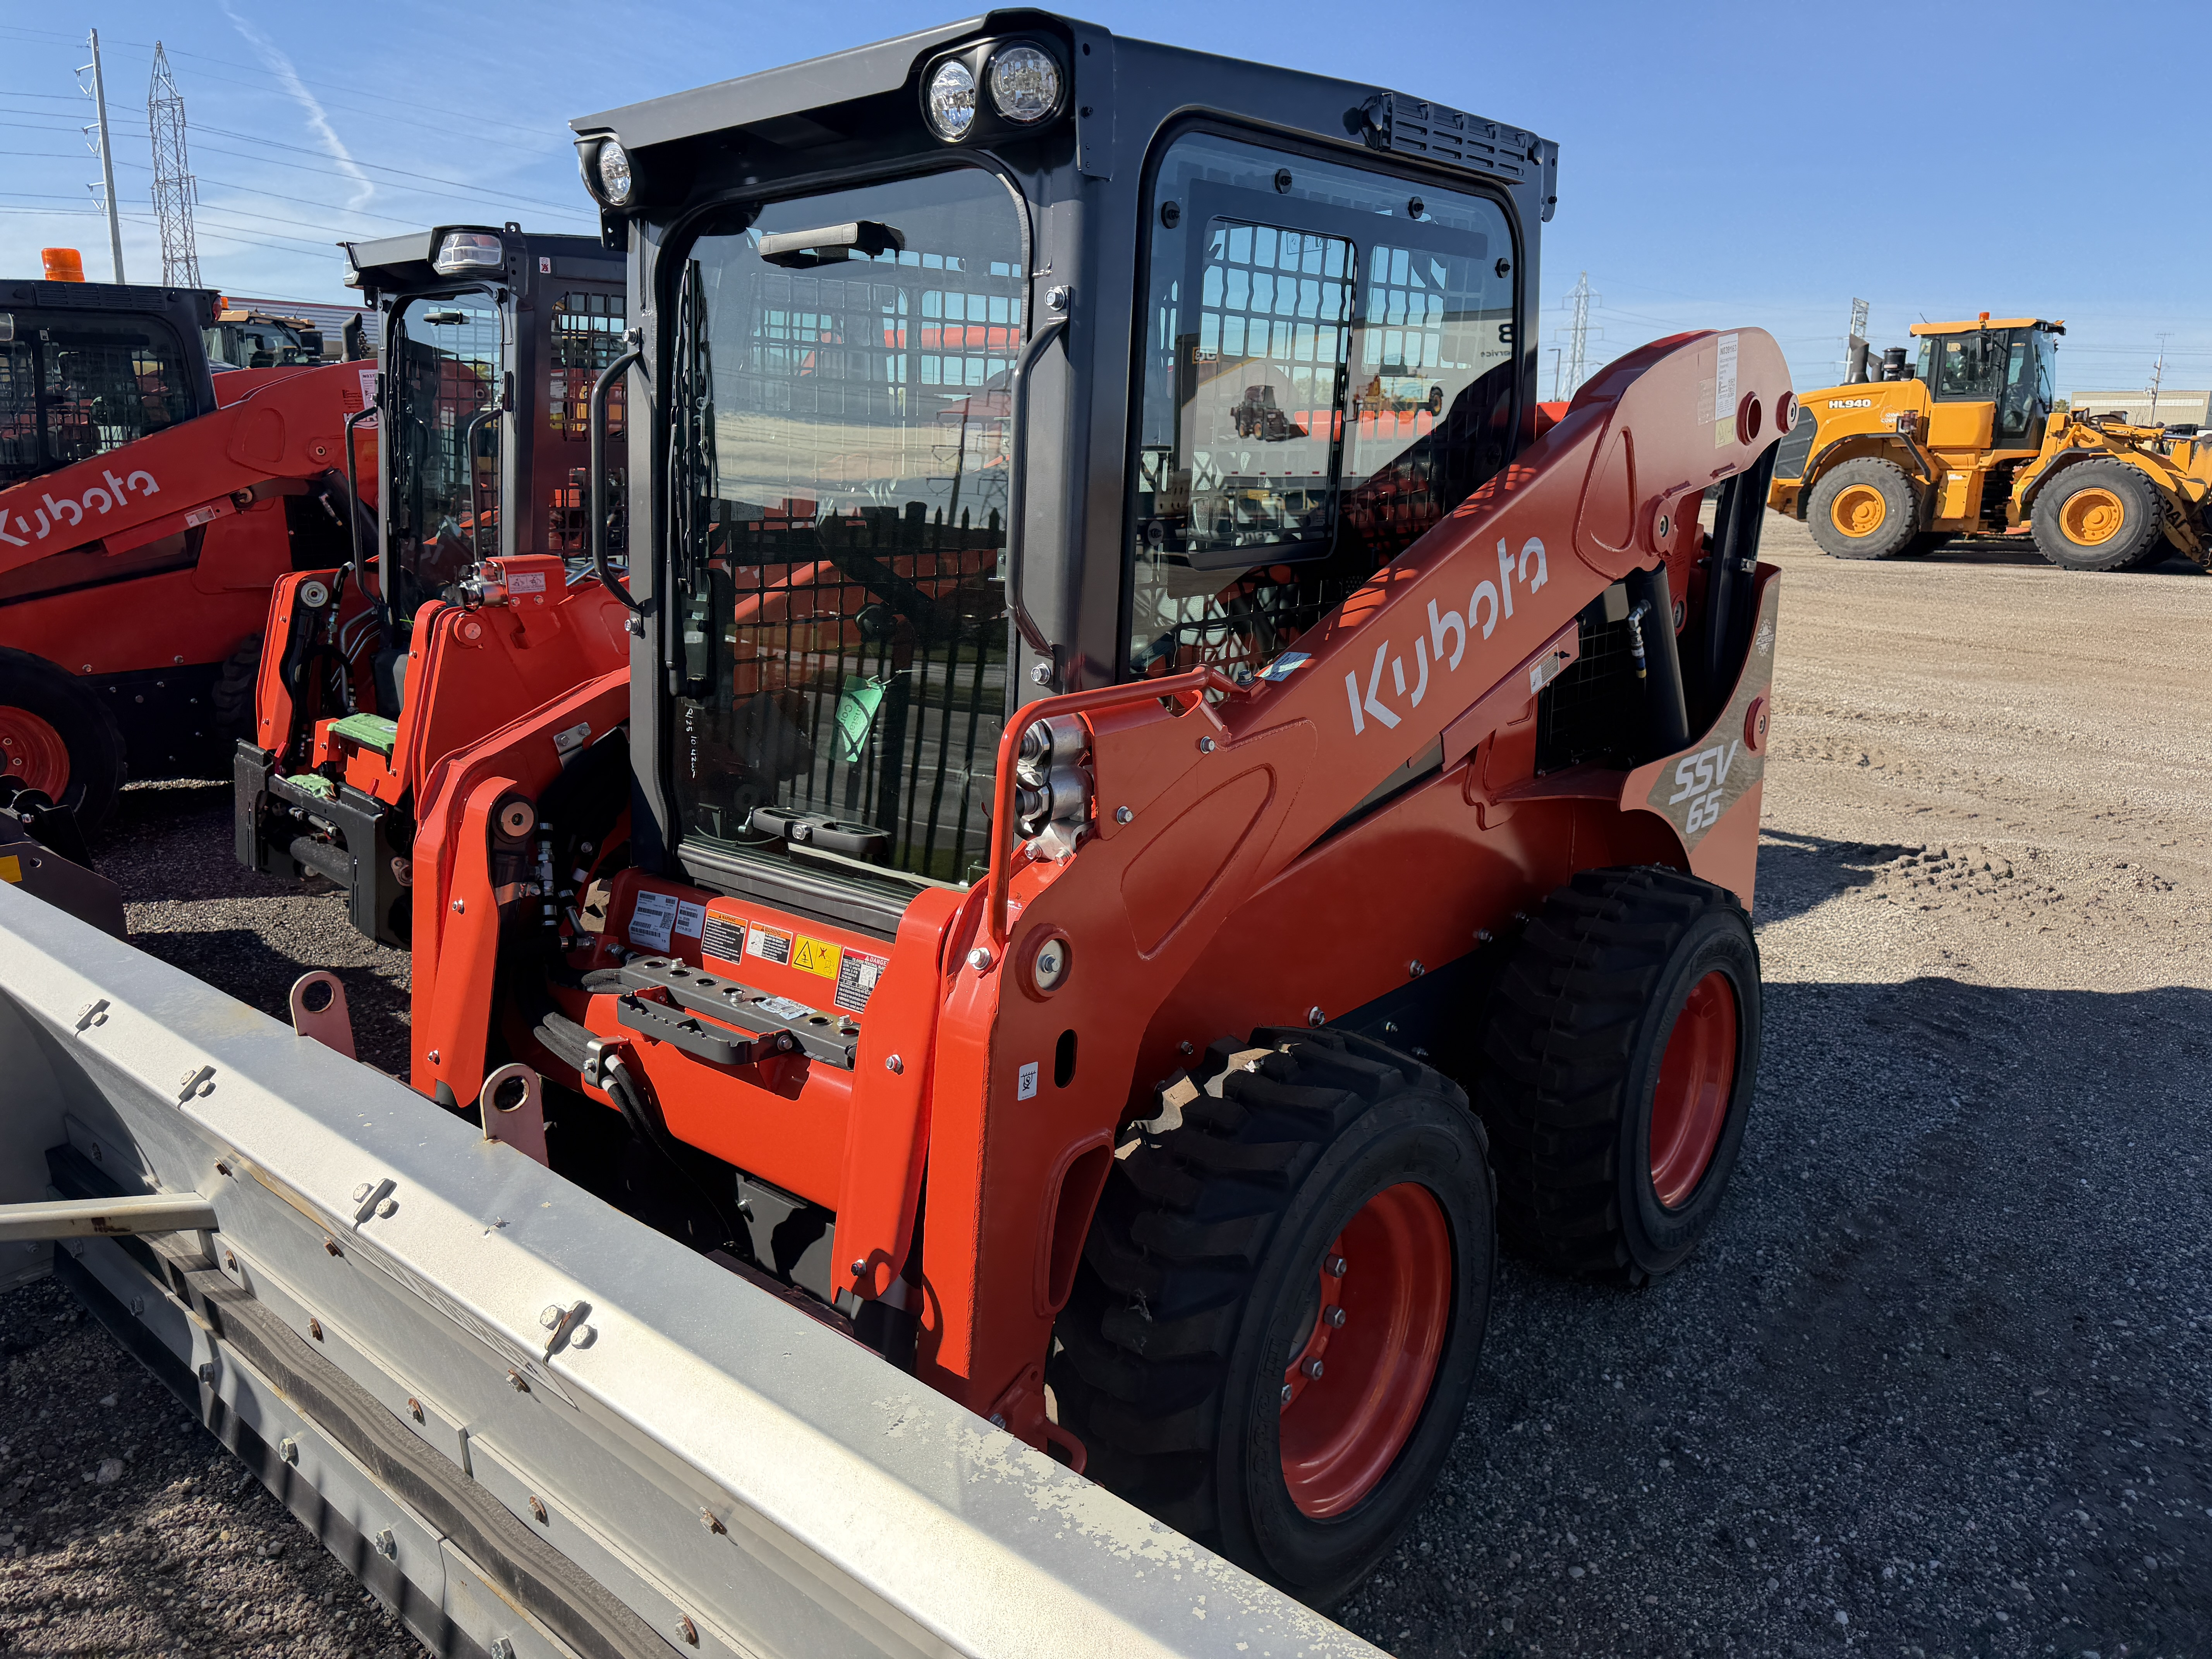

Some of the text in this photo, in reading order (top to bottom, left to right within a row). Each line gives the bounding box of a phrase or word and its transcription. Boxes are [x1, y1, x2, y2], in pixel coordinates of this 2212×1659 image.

[1829, 399, 1871, 409] HL940
[0, 469, 160, 546] Kubota
[1345, 537, 1548, 736] Kubota
[1669, 739, 1739, 805] SSV
[1685, 788, 1723, 834] 65
[870, 957, 888, 966] DANGE
